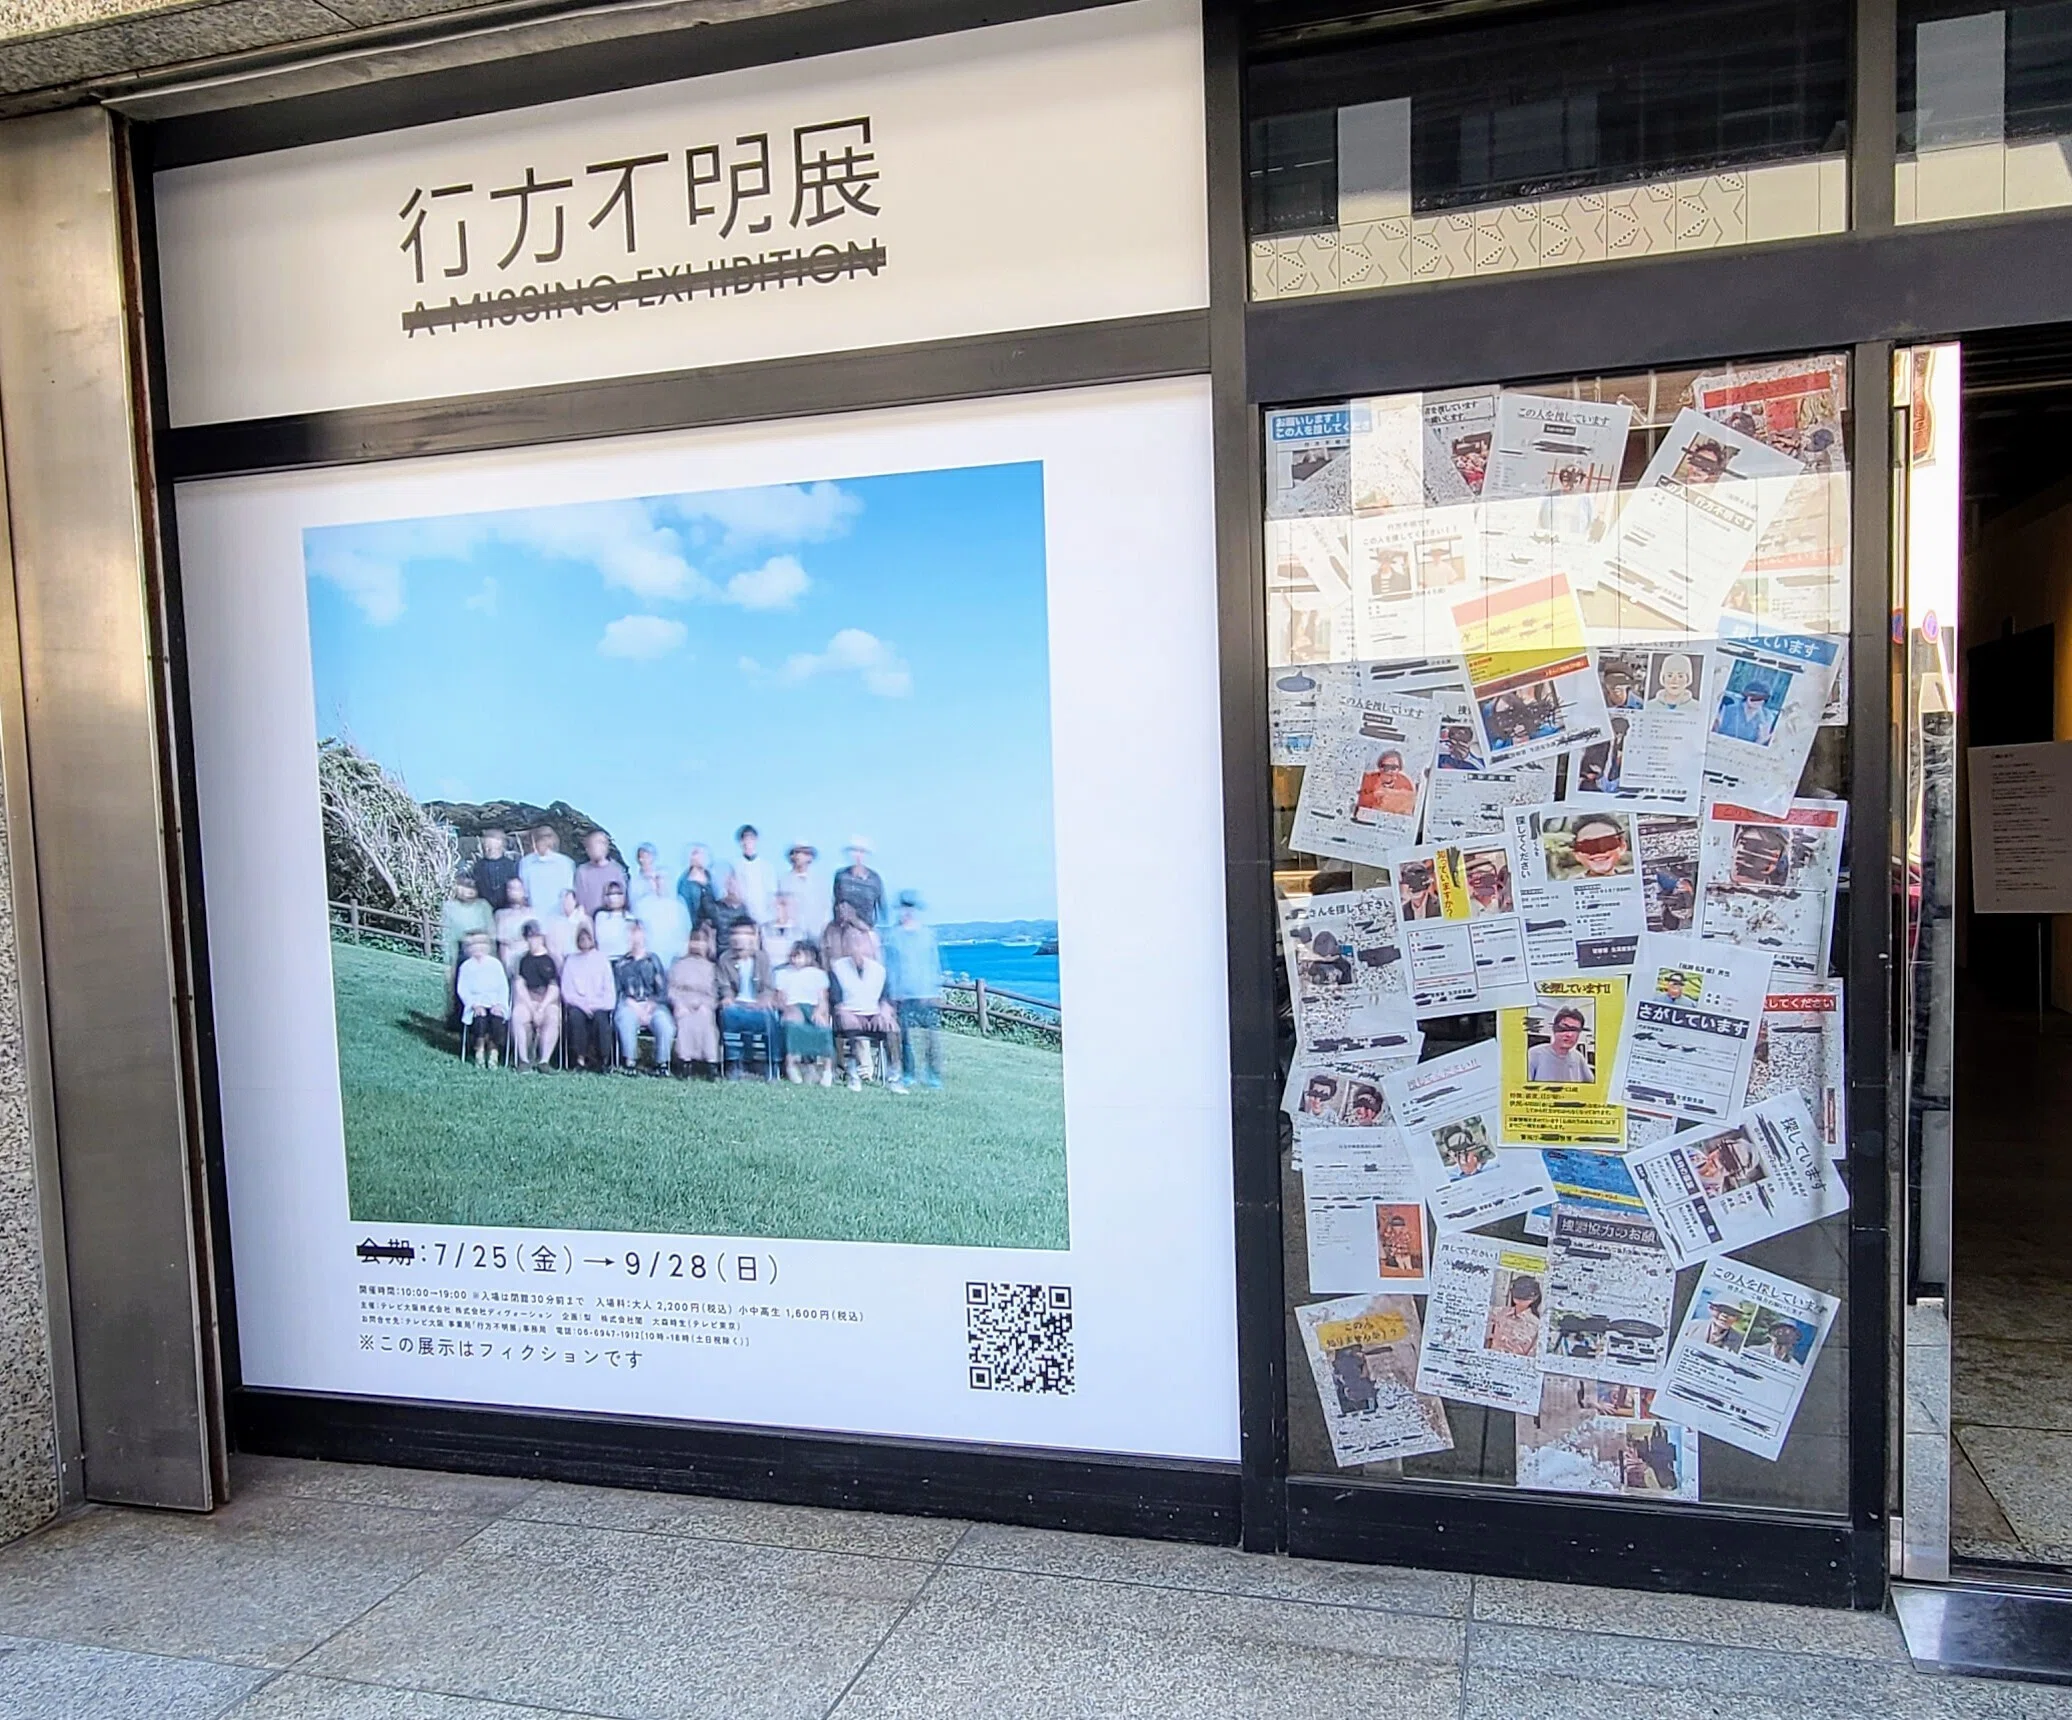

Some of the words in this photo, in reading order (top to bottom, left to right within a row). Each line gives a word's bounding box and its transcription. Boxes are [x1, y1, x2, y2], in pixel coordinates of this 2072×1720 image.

[399, 116, 881, 284] 行方不明展
[1764, 997, 1834, 1009] してください
[1639, 1004, 1749, 1037] さがしています
